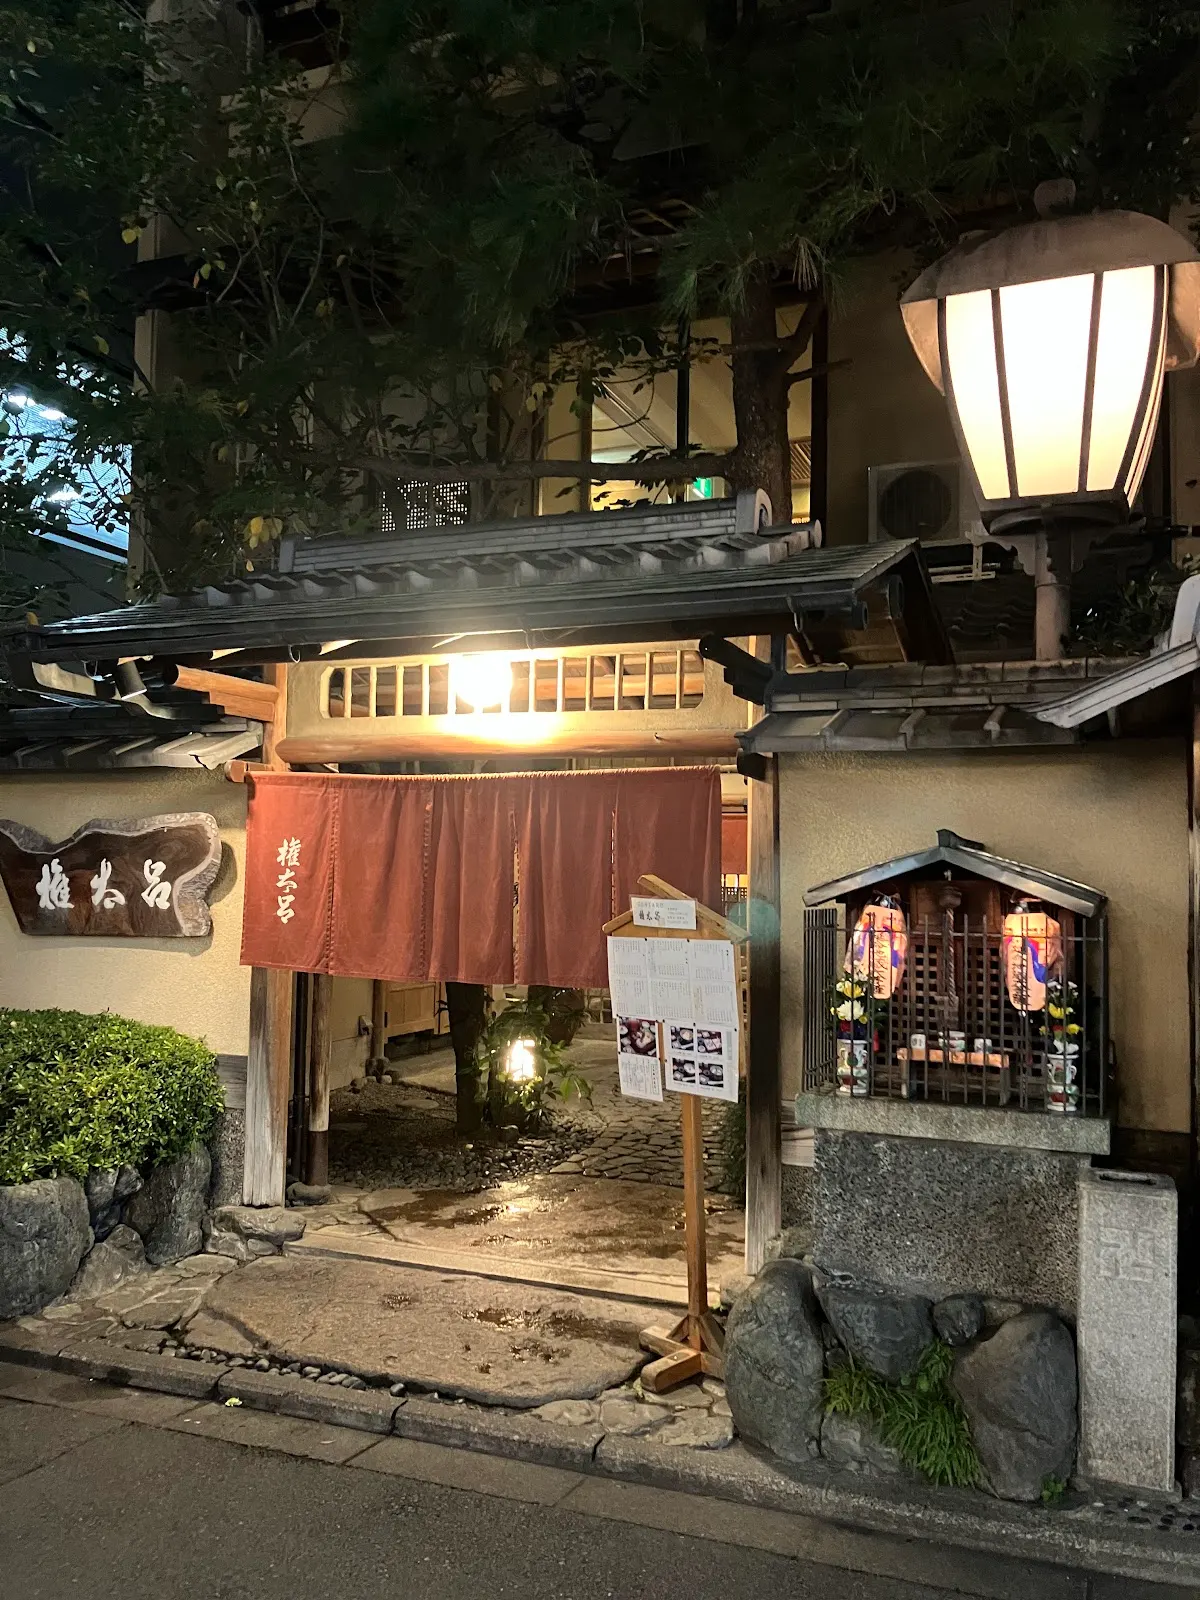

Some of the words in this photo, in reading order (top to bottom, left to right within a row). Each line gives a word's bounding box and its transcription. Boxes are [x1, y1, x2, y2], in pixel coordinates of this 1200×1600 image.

[35, 857, 173, 910] 権太呂
[276, 836, 302, 925] 権太呂
